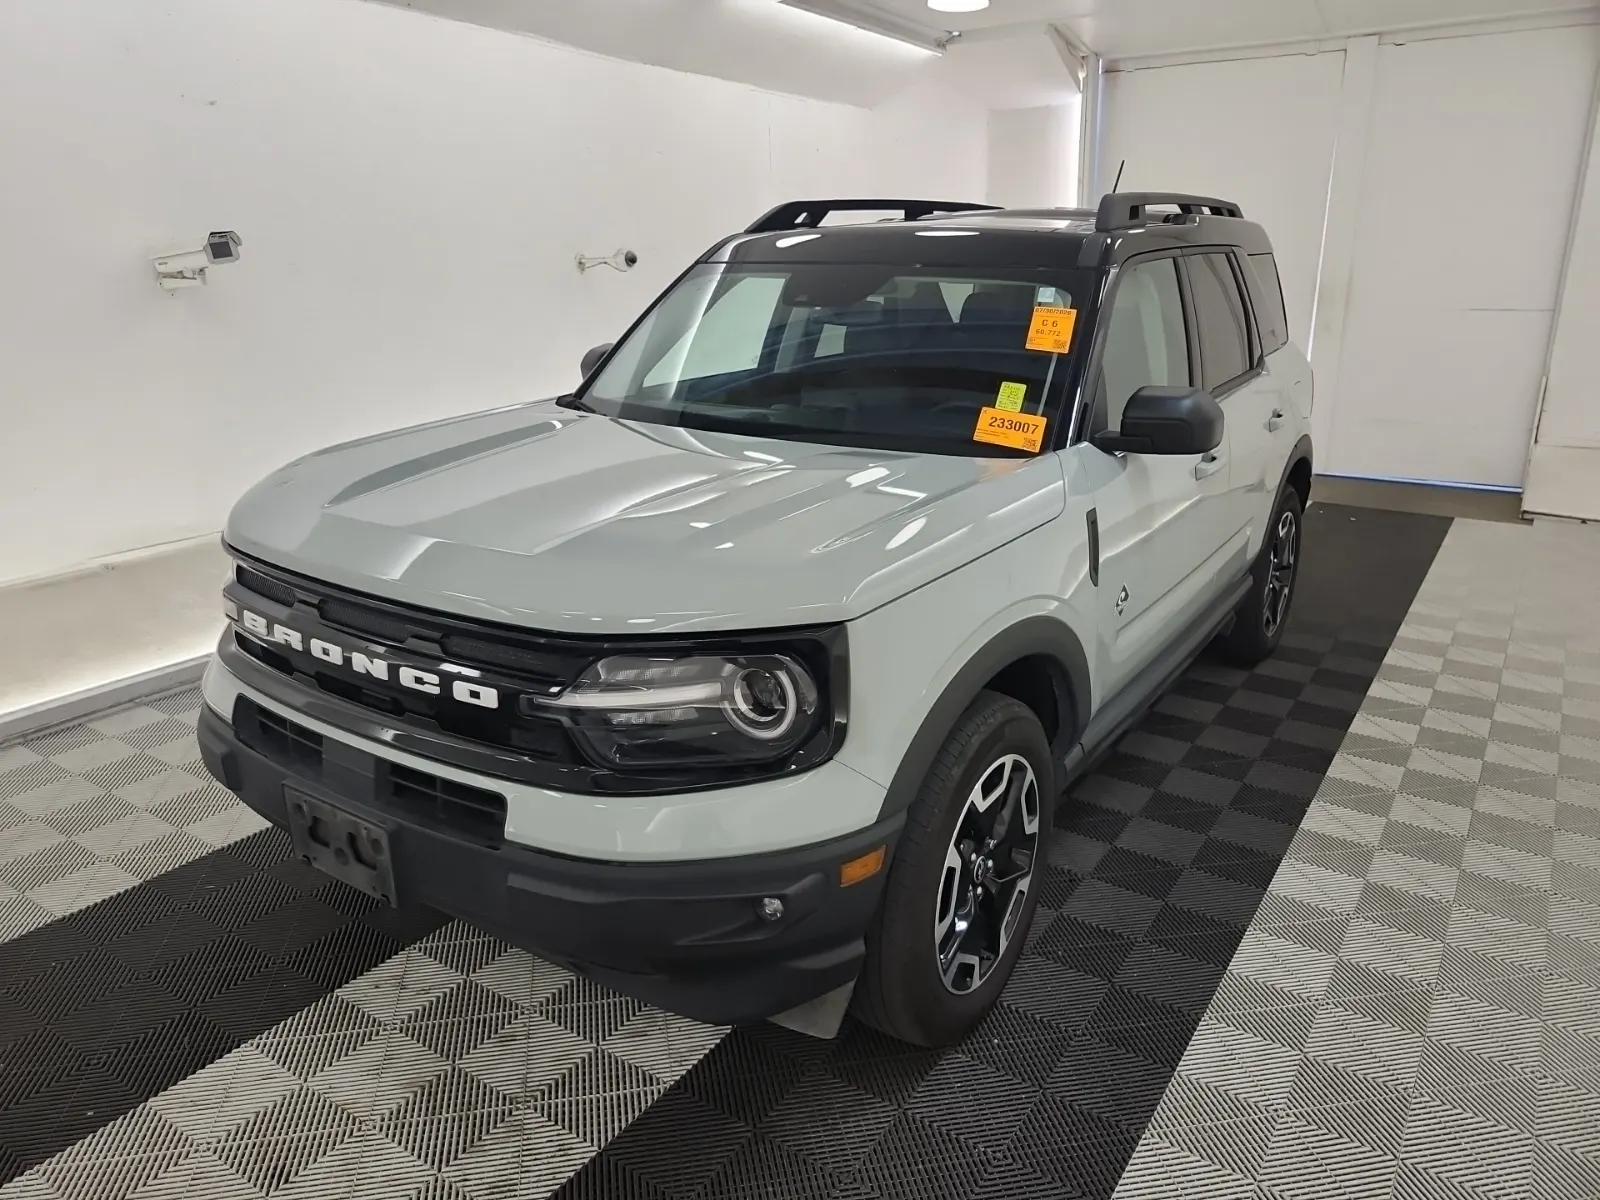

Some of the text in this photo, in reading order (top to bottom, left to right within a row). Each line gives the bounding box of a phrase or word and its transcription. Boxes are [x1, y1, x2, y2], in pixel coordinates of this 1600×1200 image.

[1052, 320, 1058, 328] 6
[988, 416, 1039, 435] 233007
[243, 609, 499, 709] BRONCO
